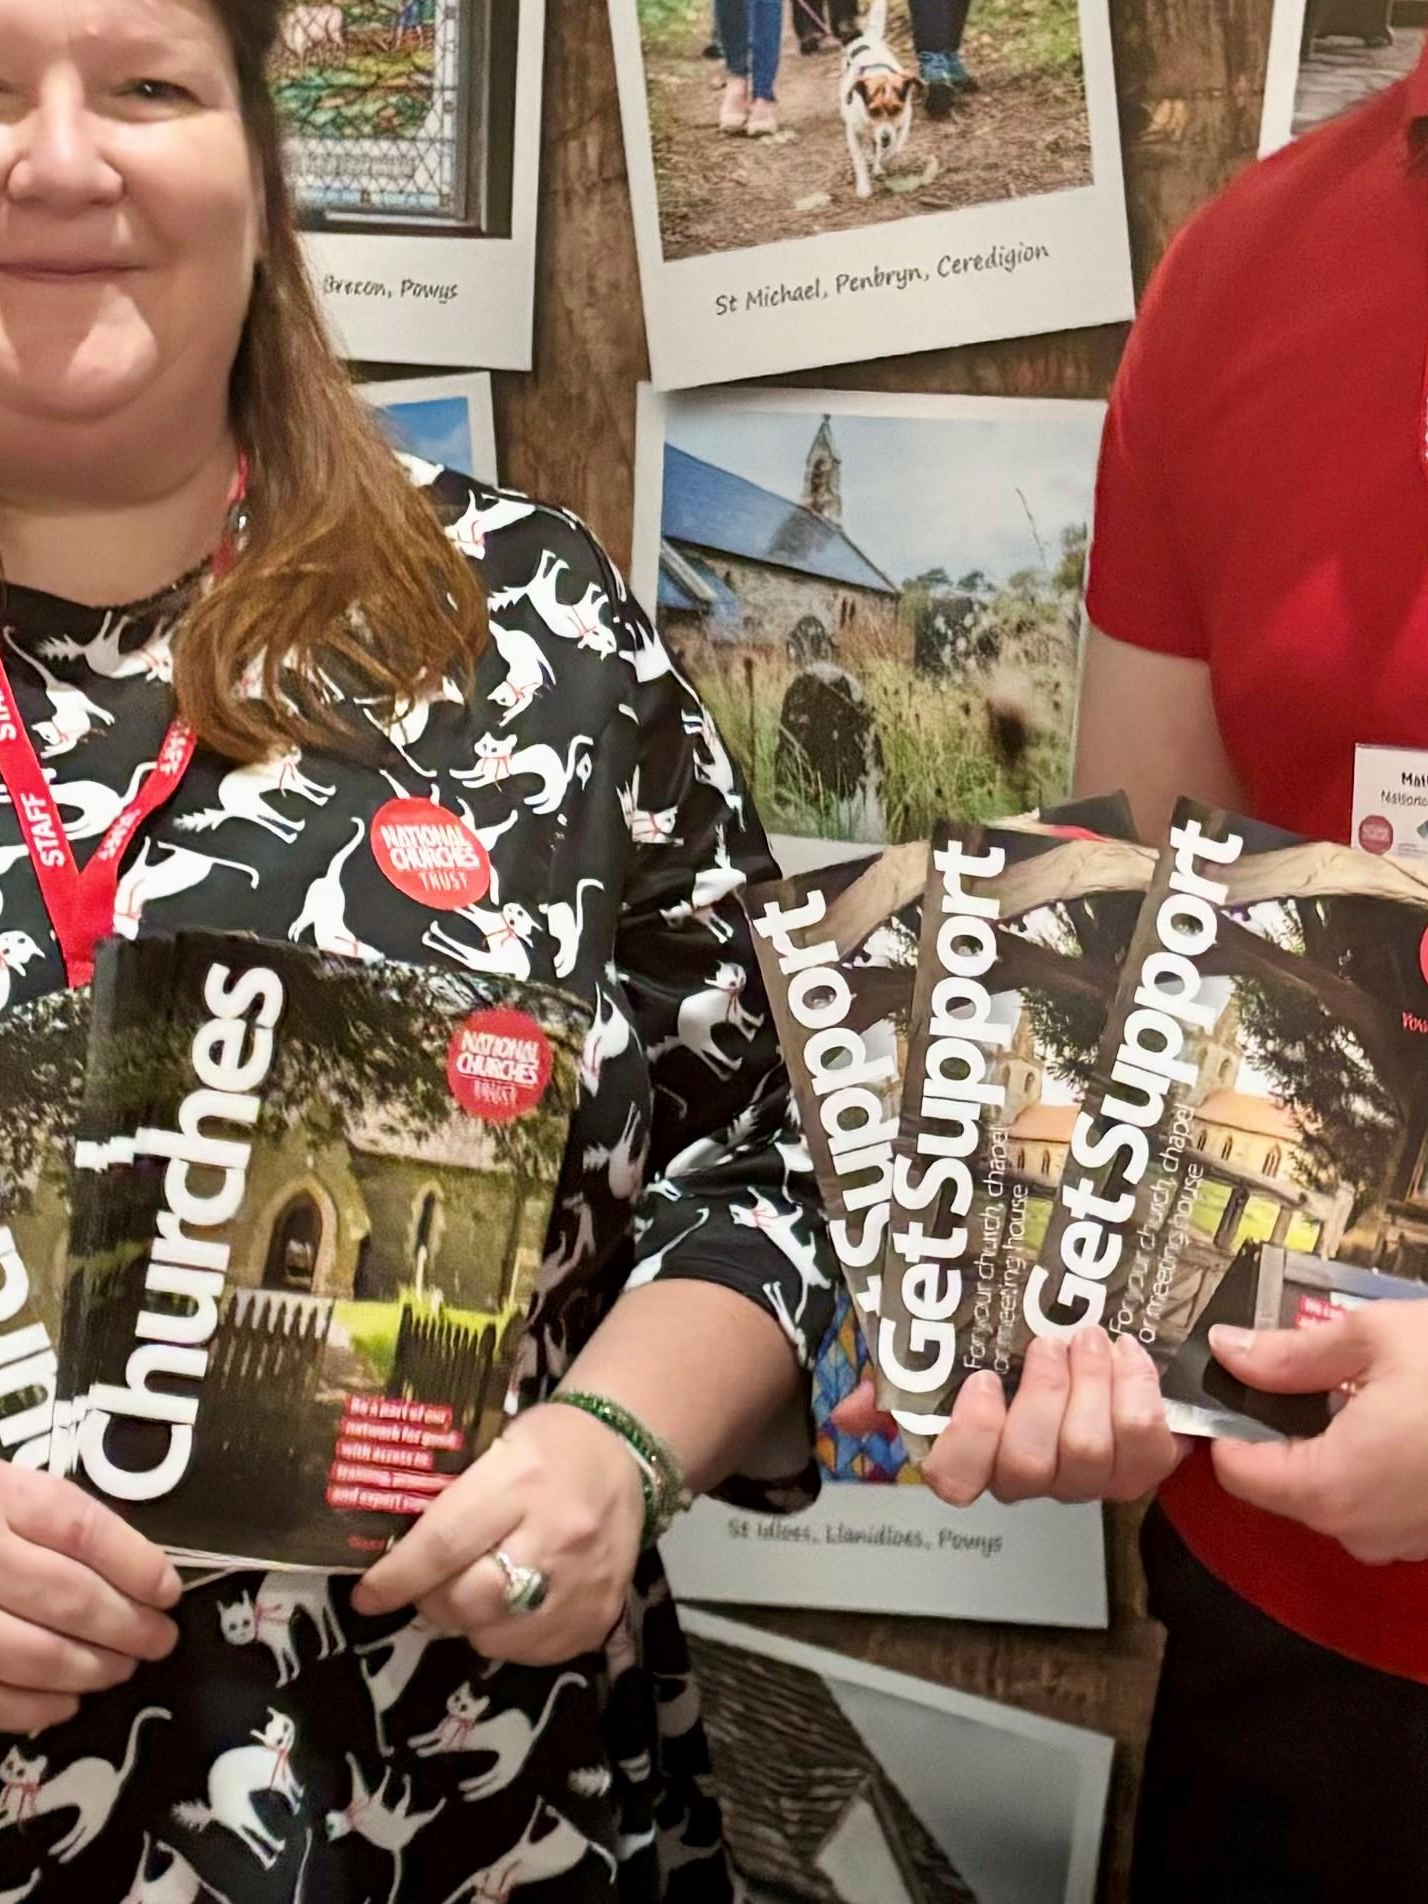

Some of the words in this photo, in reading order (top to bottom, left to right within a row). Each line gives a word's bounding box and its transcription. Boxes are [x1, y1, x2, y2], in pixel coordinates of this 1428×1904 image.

[400, 277, 459, 304] Powys
[715, 294, 738, 315] St
[745, 278, 828, 310] Michael,
[836, 264, 930, 296] Penbryn,
[937, 242, 1049, 275] Ceredigion
[20, 791, 66, 868] STAFF
[379, 821, 467, 851] NATIONAL
[388, 846, 481, 872] CHURCHES
[417, 870, 469, 892] TRUST
[892, 839, 1006, 1219] Support
[1070, 818, 1245, 1187] Support
[455, 1051, 540, 1087] CHURCHES
[460, 1029, 540, 1063] NATIONAL
[753, 889, 900, 1270] Support
[1158, 1104, 1196, 1174] chapel
[76, 961, 285, 1502] Churches
[1022, 1174, 1137, 1341] Get
[876, 1220, 968, 1395] Get
[938, 1527, 1003, 1558] Powys
